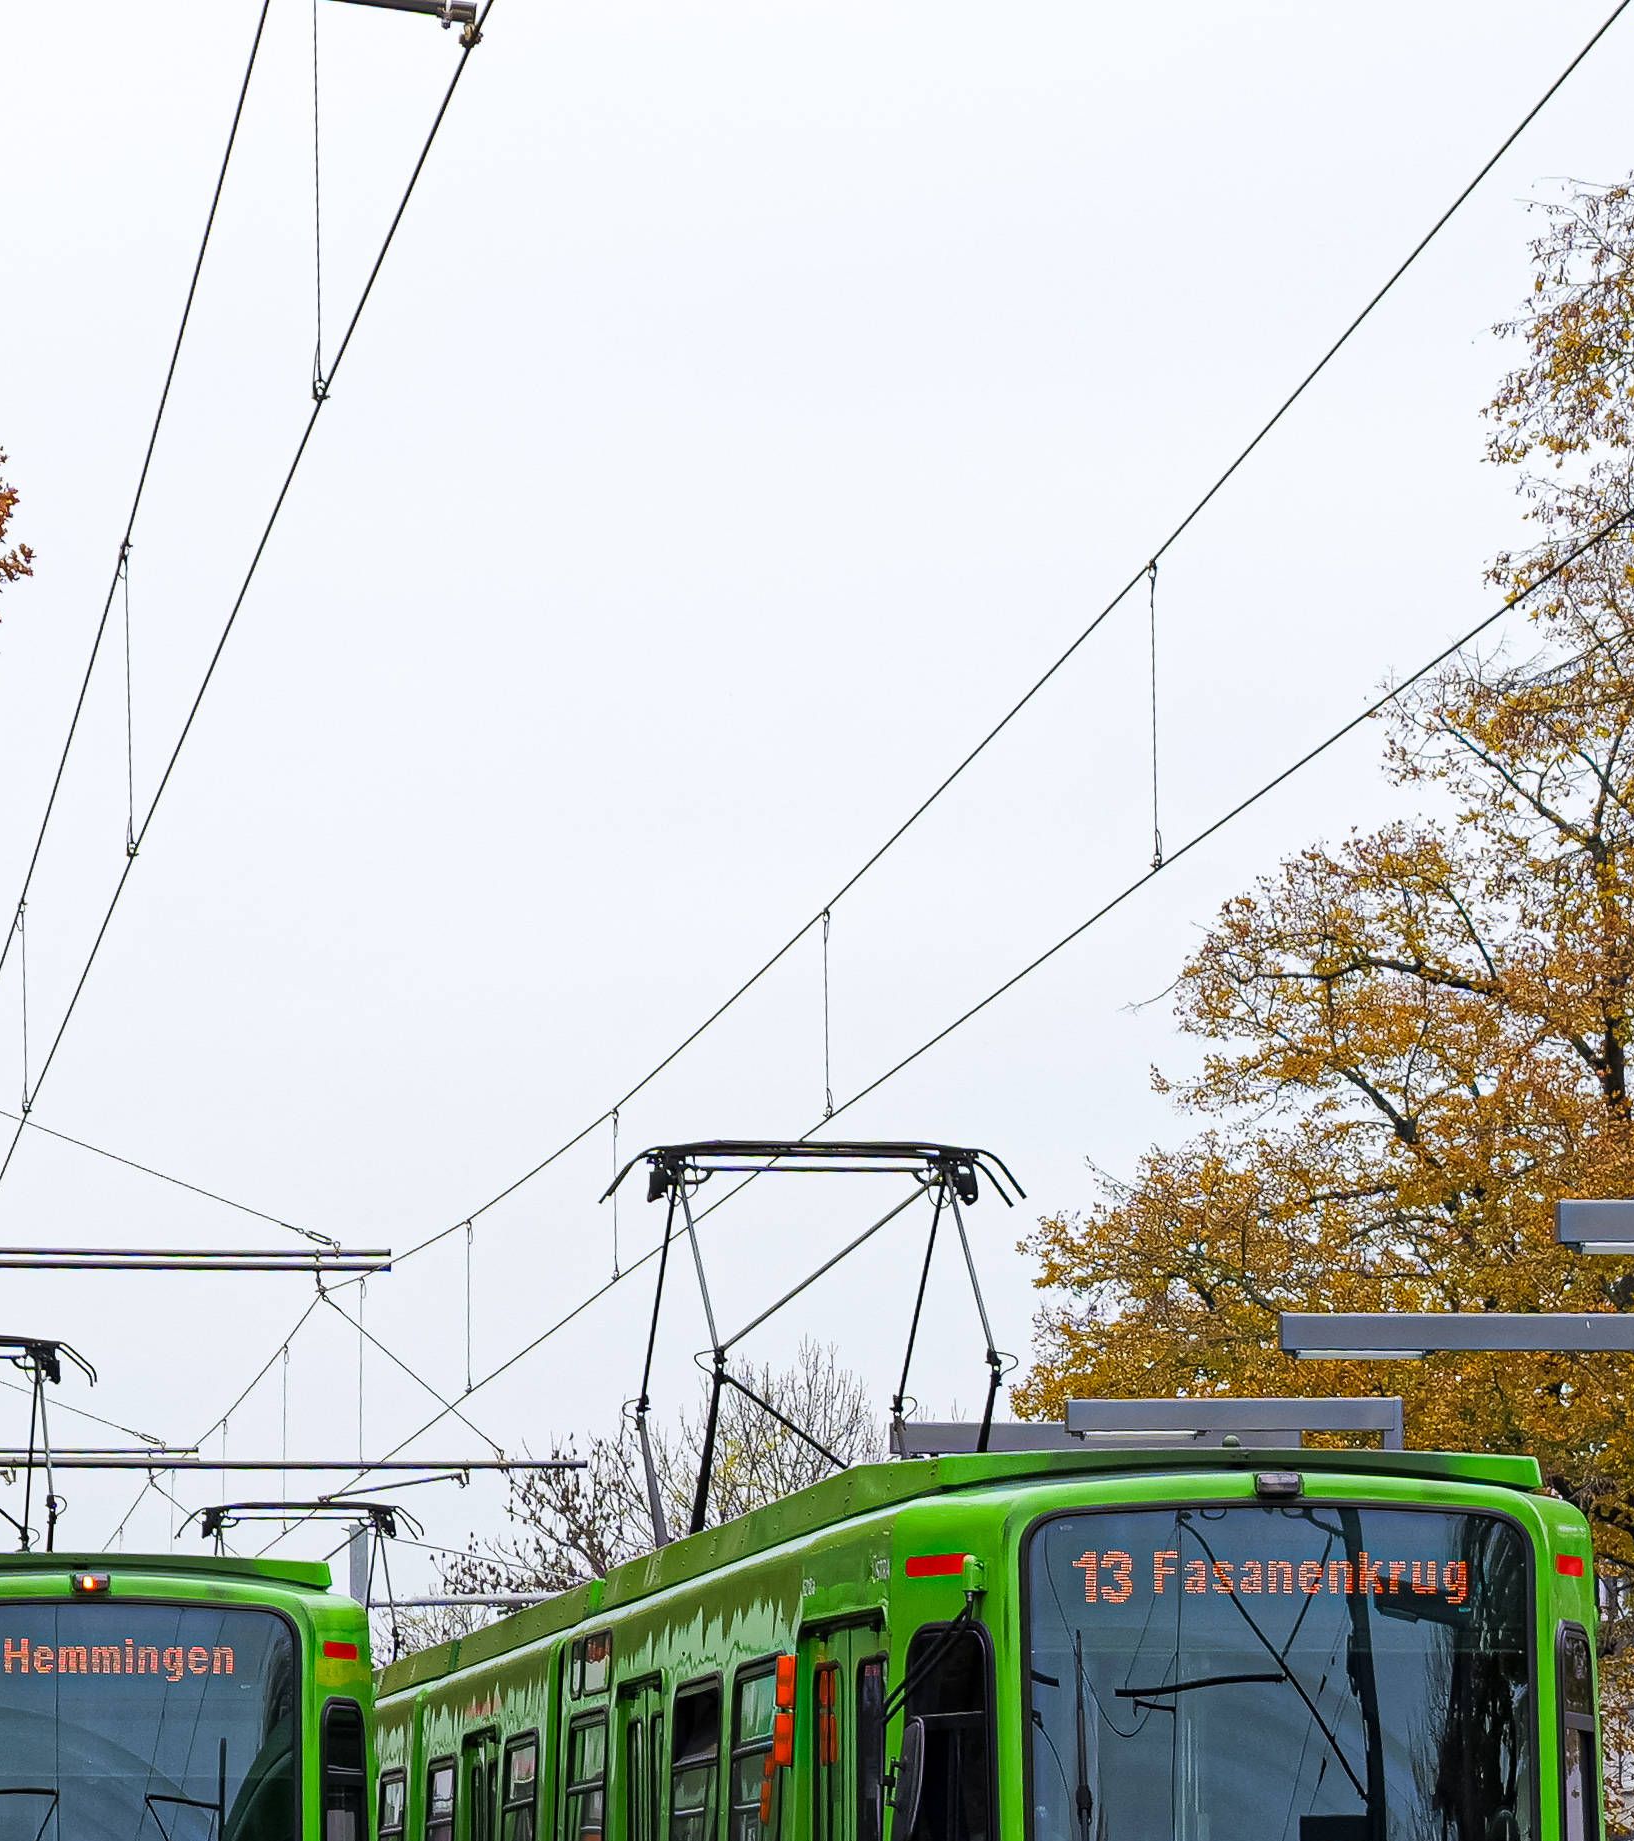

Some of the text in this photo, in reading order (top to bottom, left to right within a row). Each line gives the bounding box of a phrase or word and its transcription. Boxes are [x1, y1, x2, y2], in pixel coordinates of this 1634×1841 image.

[1072, 1551, 1468, 1605] 13 Fasanenkrug
[3, 1637, 235, 1682] Hemmingen
